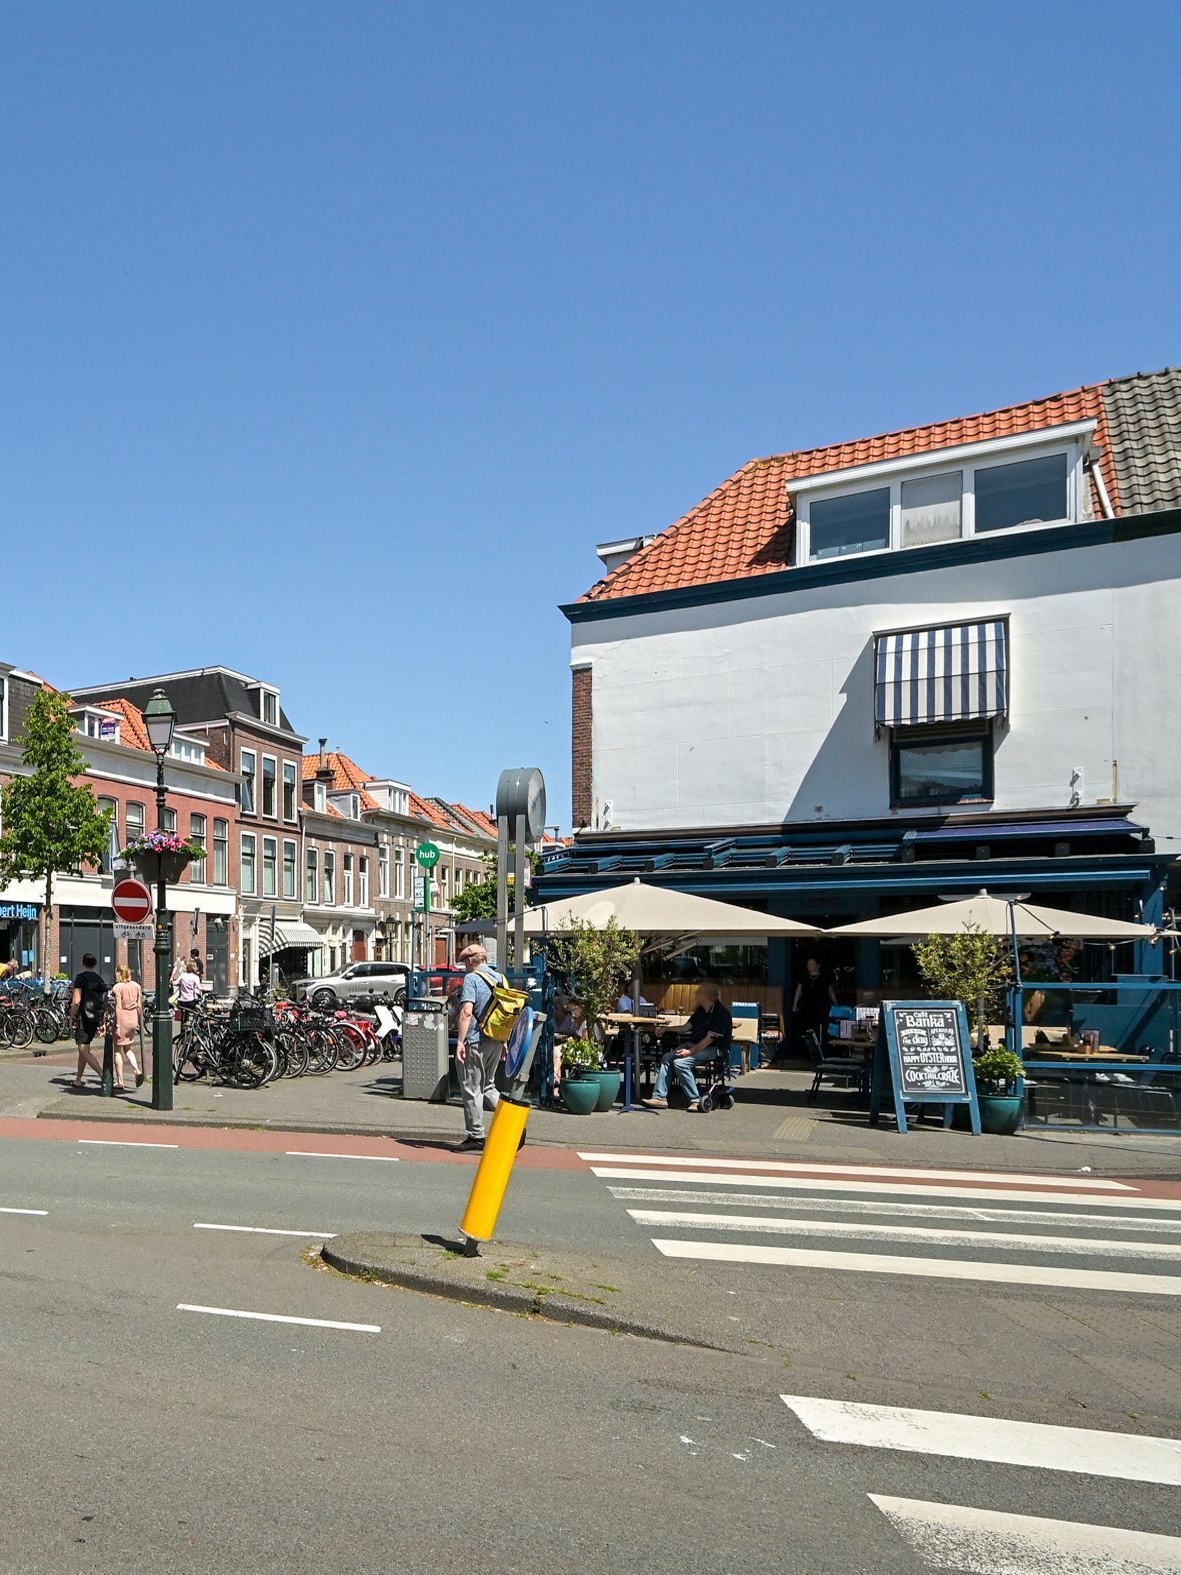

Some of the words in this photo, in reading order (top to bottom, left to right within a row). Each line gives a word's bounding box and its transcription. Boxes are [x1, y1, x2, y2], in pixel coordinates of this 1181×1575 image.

[419, 850, 436, 858] hub
[16, 904, 37, 920] Heijn
[905, 1014, 945, 1027] Banka
[912, 1033, 929, 1046] day
[920, 1053, 944, 1063] OYSTER
